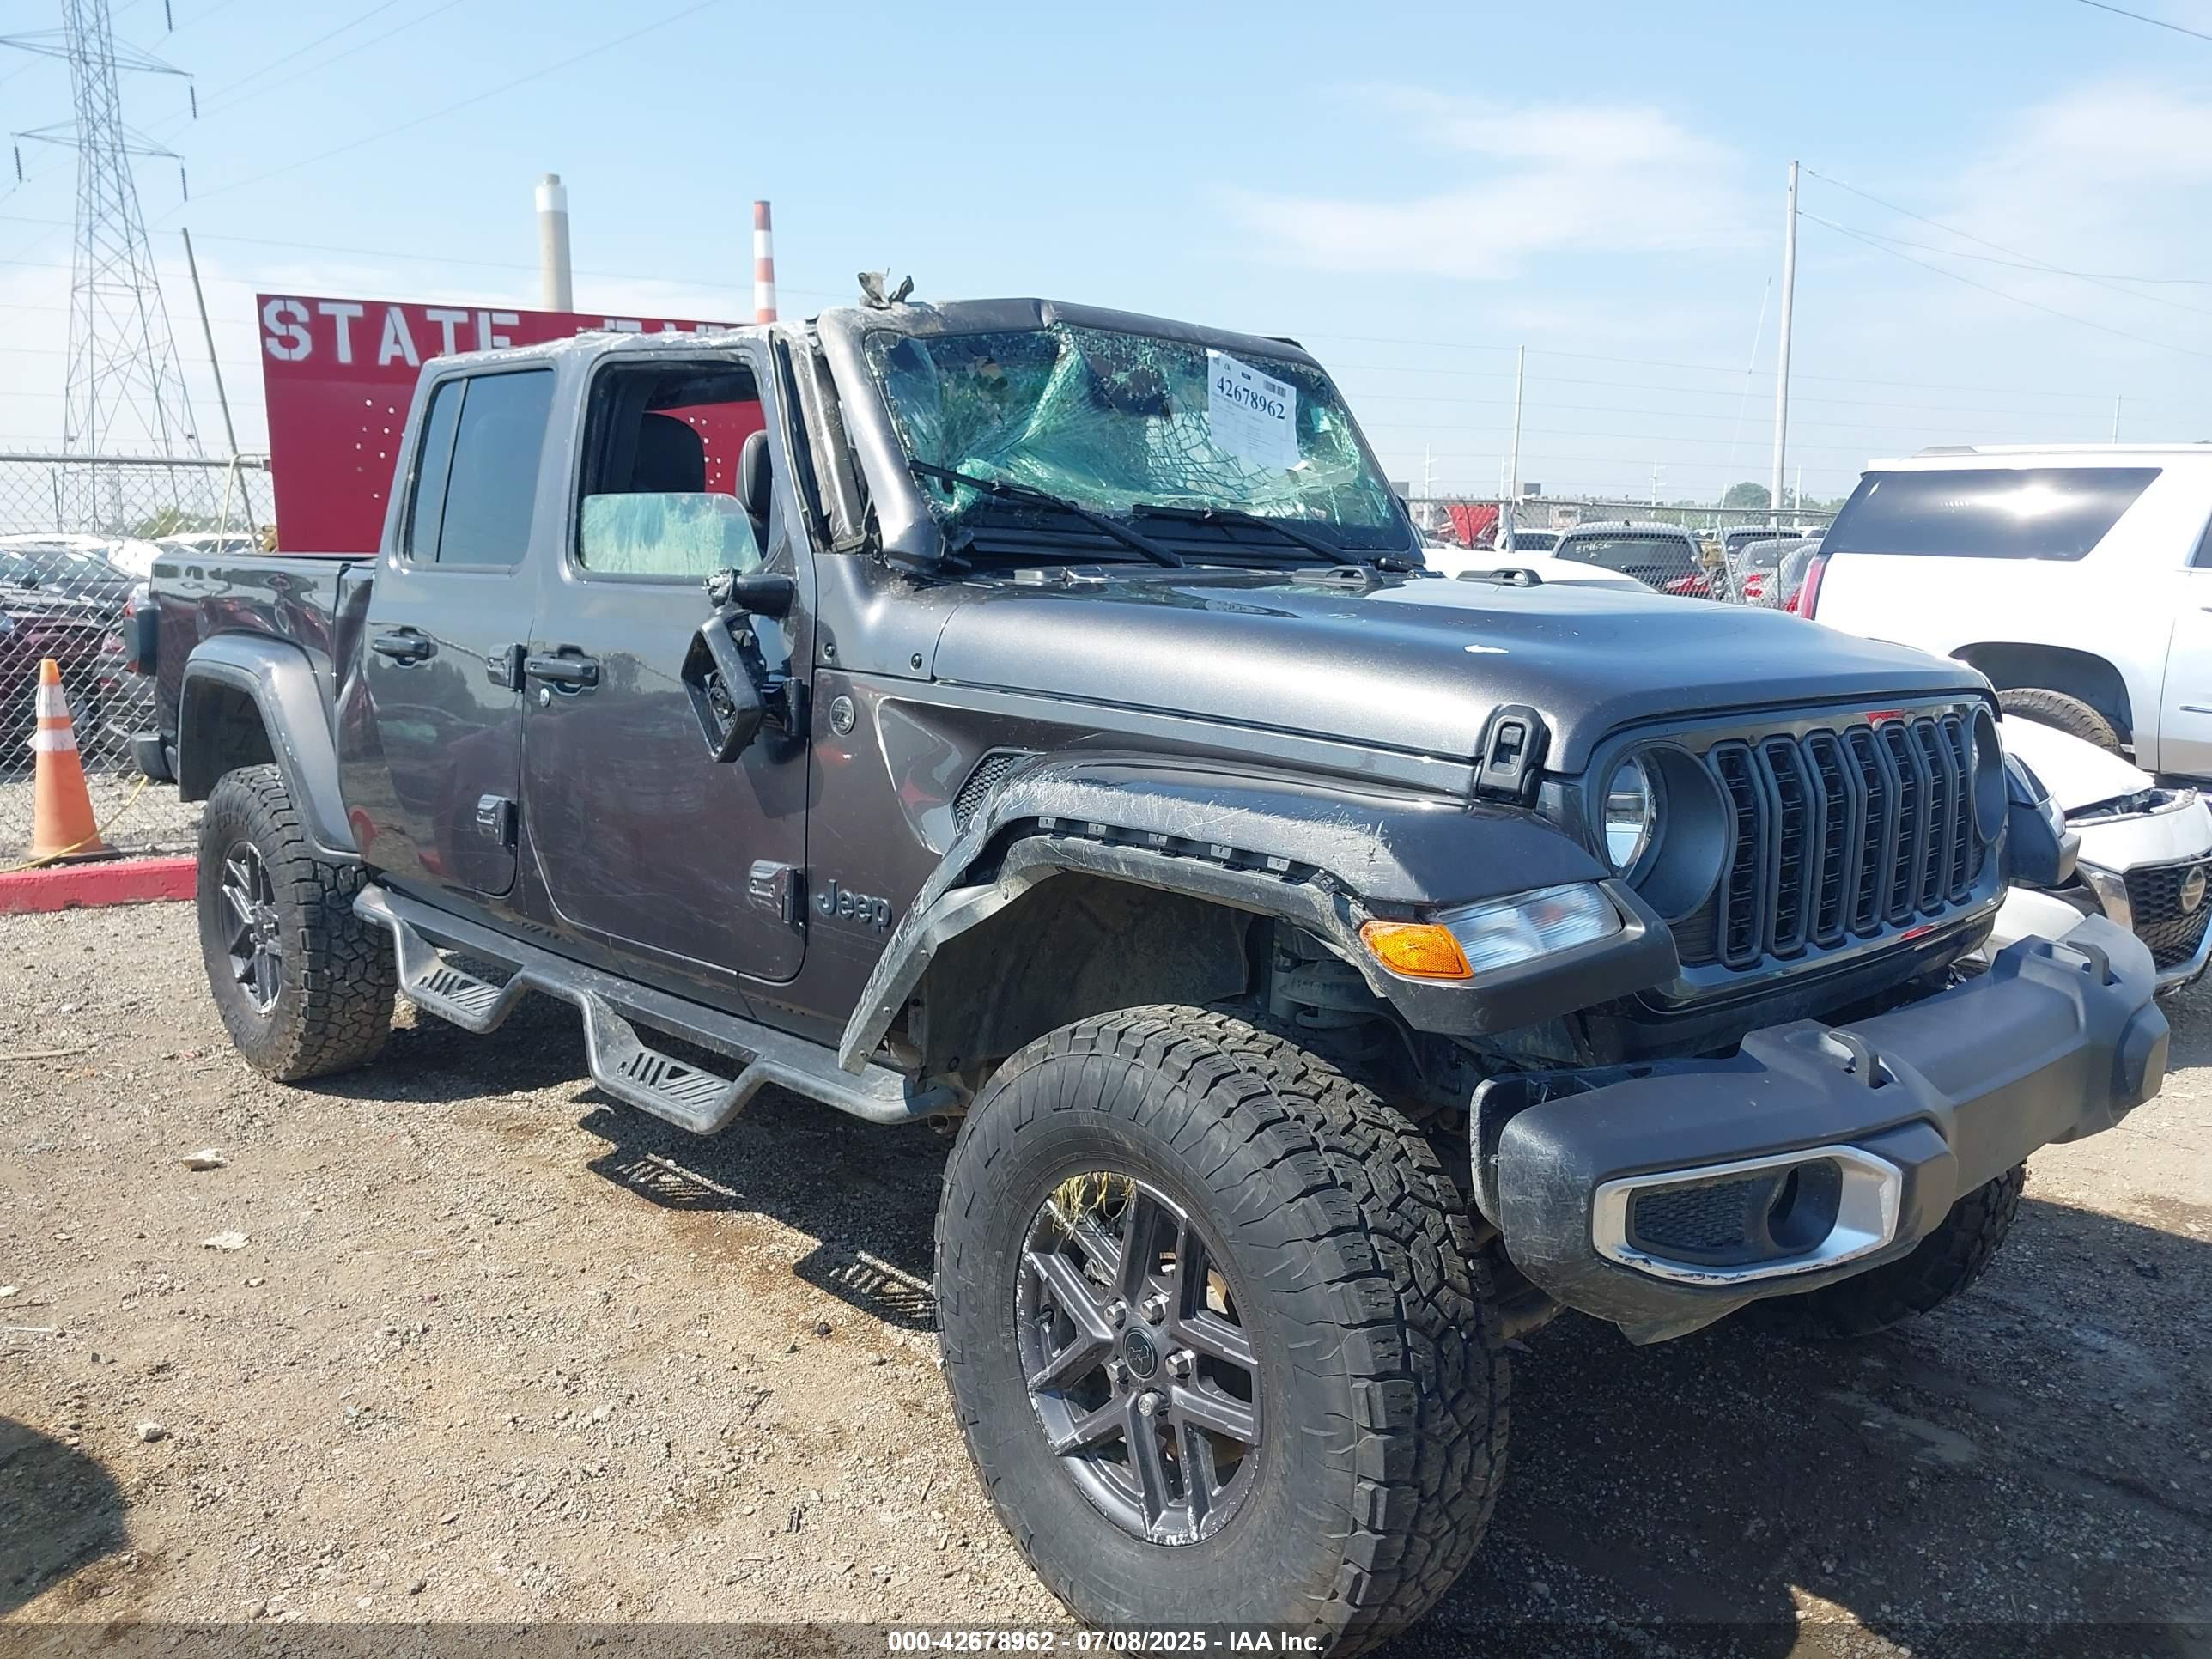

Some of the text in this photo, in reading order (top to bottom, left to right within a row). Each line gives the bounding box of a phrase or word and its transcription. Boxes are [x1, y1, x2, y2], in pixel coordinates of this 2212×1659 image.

[263, 299, 520, 367] STATE
[1216, 376, 1285, 420] 42678962
[817, 878, 892, 933] Jeep
